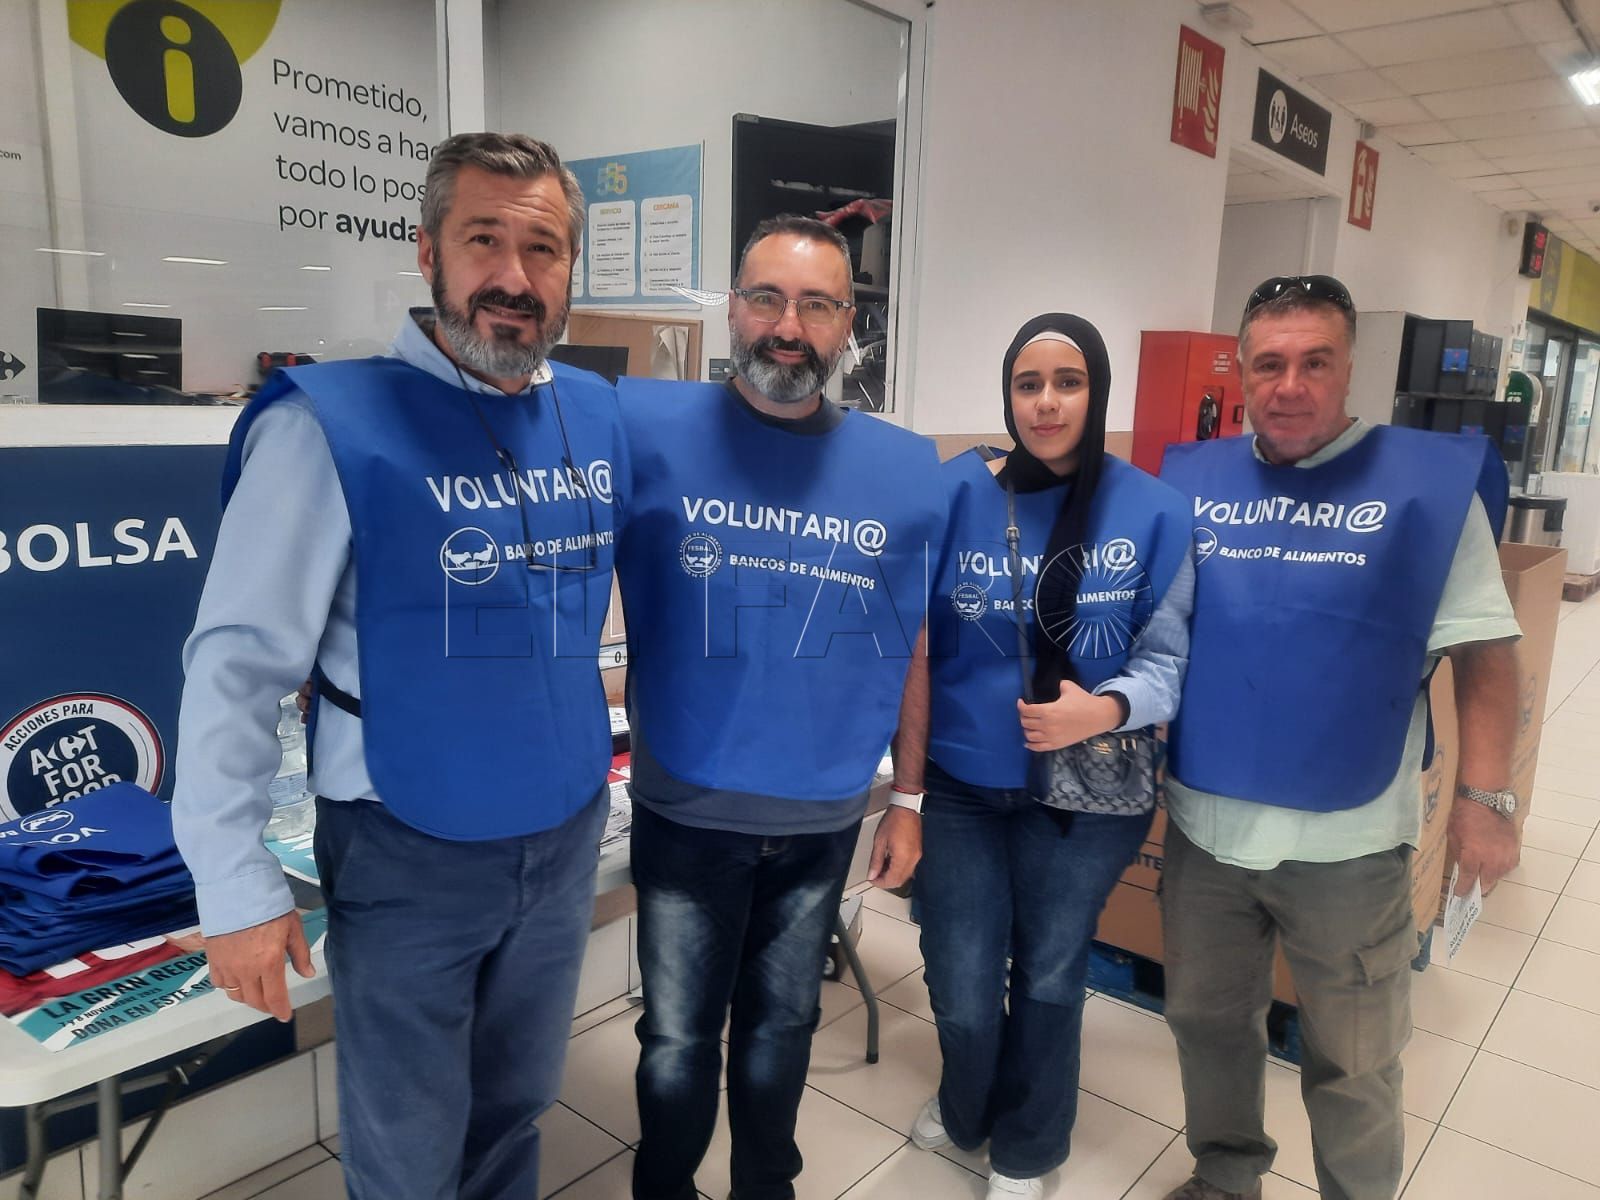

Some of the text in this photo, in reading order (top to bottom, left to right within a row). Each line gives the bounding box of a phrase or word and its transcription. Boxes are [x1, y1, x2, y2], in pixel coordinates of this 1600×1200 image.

[273, 58, 428, 124] Prometido,
[273, 111, 371, 150] vamos
[377, 133, 393, 154] a
[1290, 113, 1319, 148] Aseos
[275, 154, 346, 188] todo
[352, 165, 376, 194] lo
[279, 204, 329, 231] por
[682, 495, 887, 557] VOLUNTARI@
[1193, 496, 1387, 533] VOLUNTARI@
[546, 538, 562, 554] DE
[1218, 546, 1367, 566] BANCO DE ALIMENTOS
[729, 554, 786, 572] BANCOS
[789, 561, 807, 575] DE
[809, 566, 876, 590] ALIMENTOS
[1075, 590, 1136, 604] LIMENTOS
[4, 703, 94, 752] ACCIONES PARA
[43, 754, 106, 797] FOR
[42, 1001, 82, 1019] LA
[79, 975, 150, 1005] GRAN
[71, 1013, 127, 1039] DONA
[123, 1003, 151, 1018] EN
[151, 988, 192, 1010] ESTE
